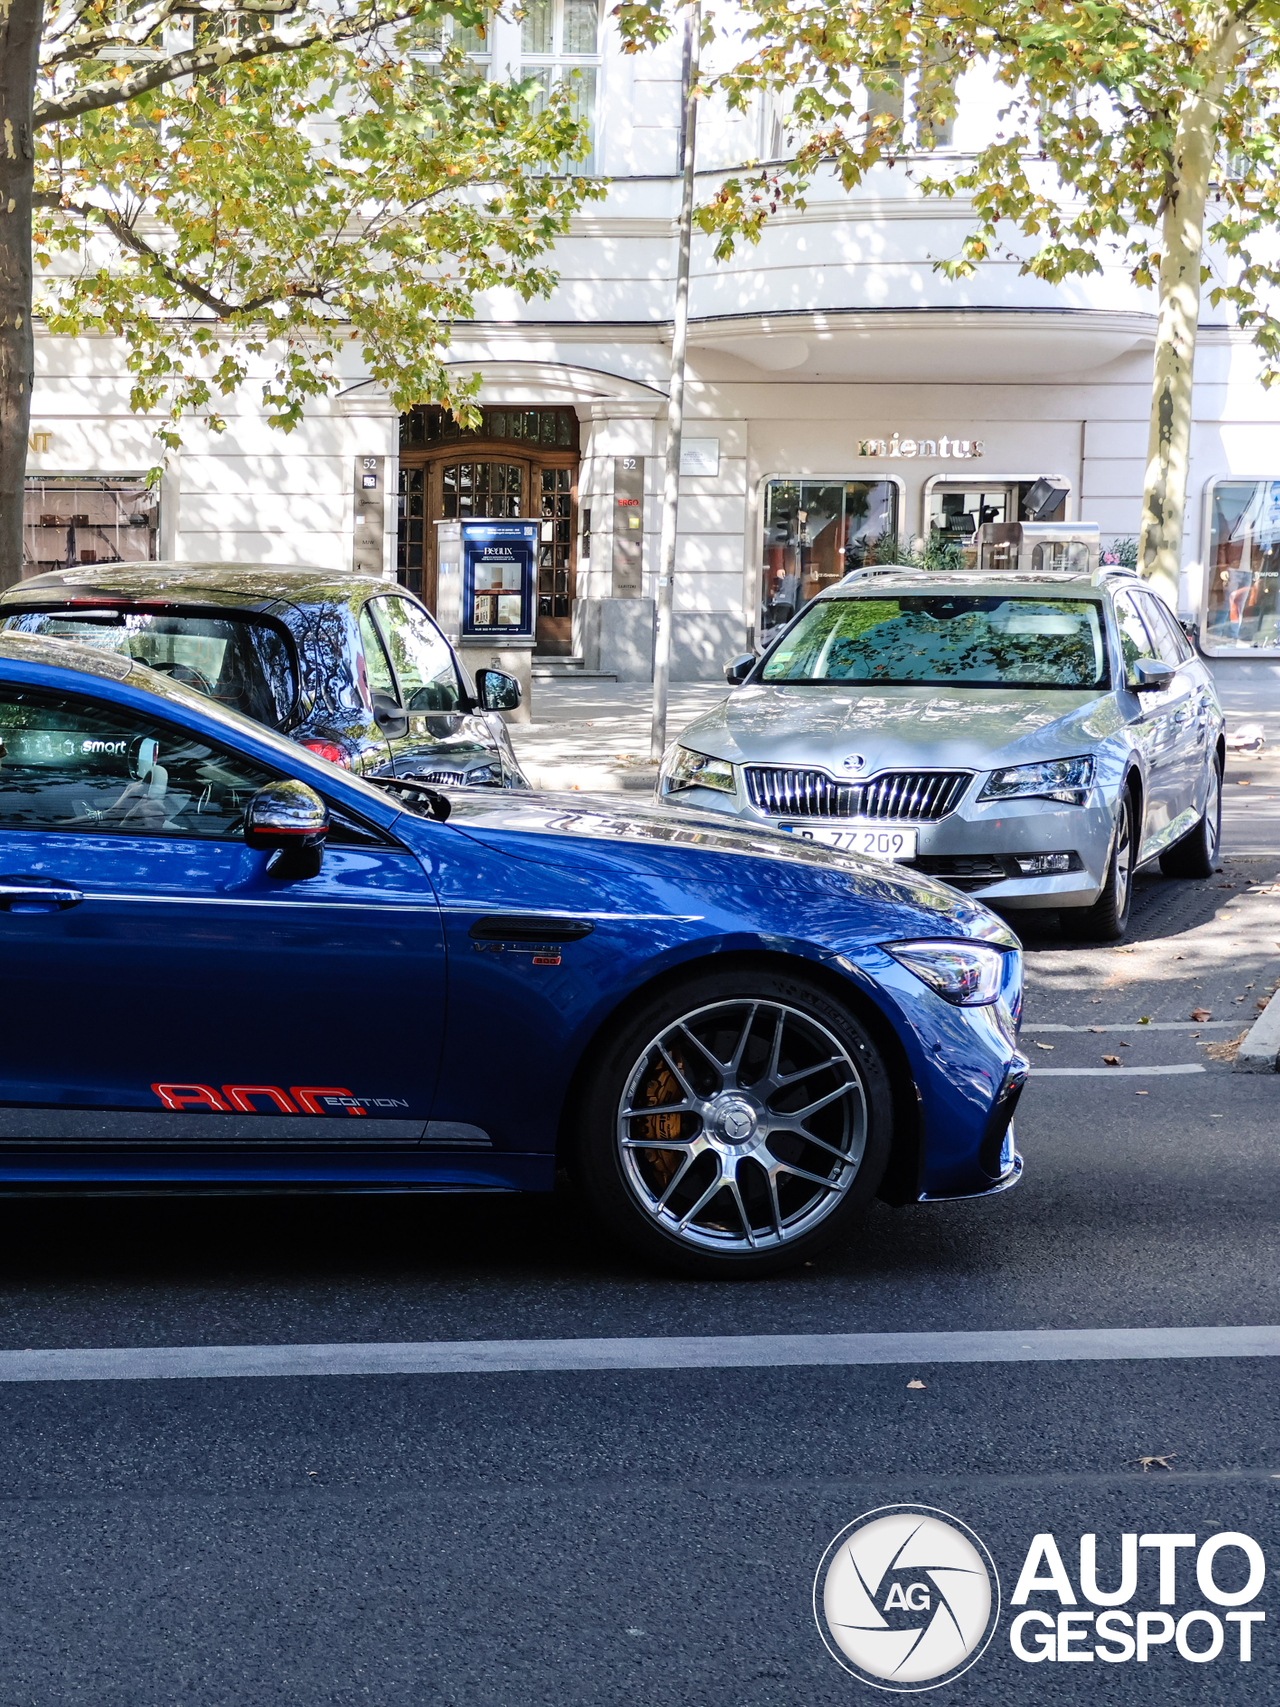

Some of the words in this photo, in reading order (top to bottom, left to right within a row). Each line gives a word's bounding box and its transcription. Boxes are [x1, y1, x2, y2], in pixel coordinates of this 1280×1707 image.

[858, 432, 985, 458] mientus
[363, 459, 376, 469] 52
[623, 459, 636, 469] 52
[82, 740, 127, 754] smart
[863, 833, 904, 853] 209
[323, 1096, 409, 1108] EDITION
